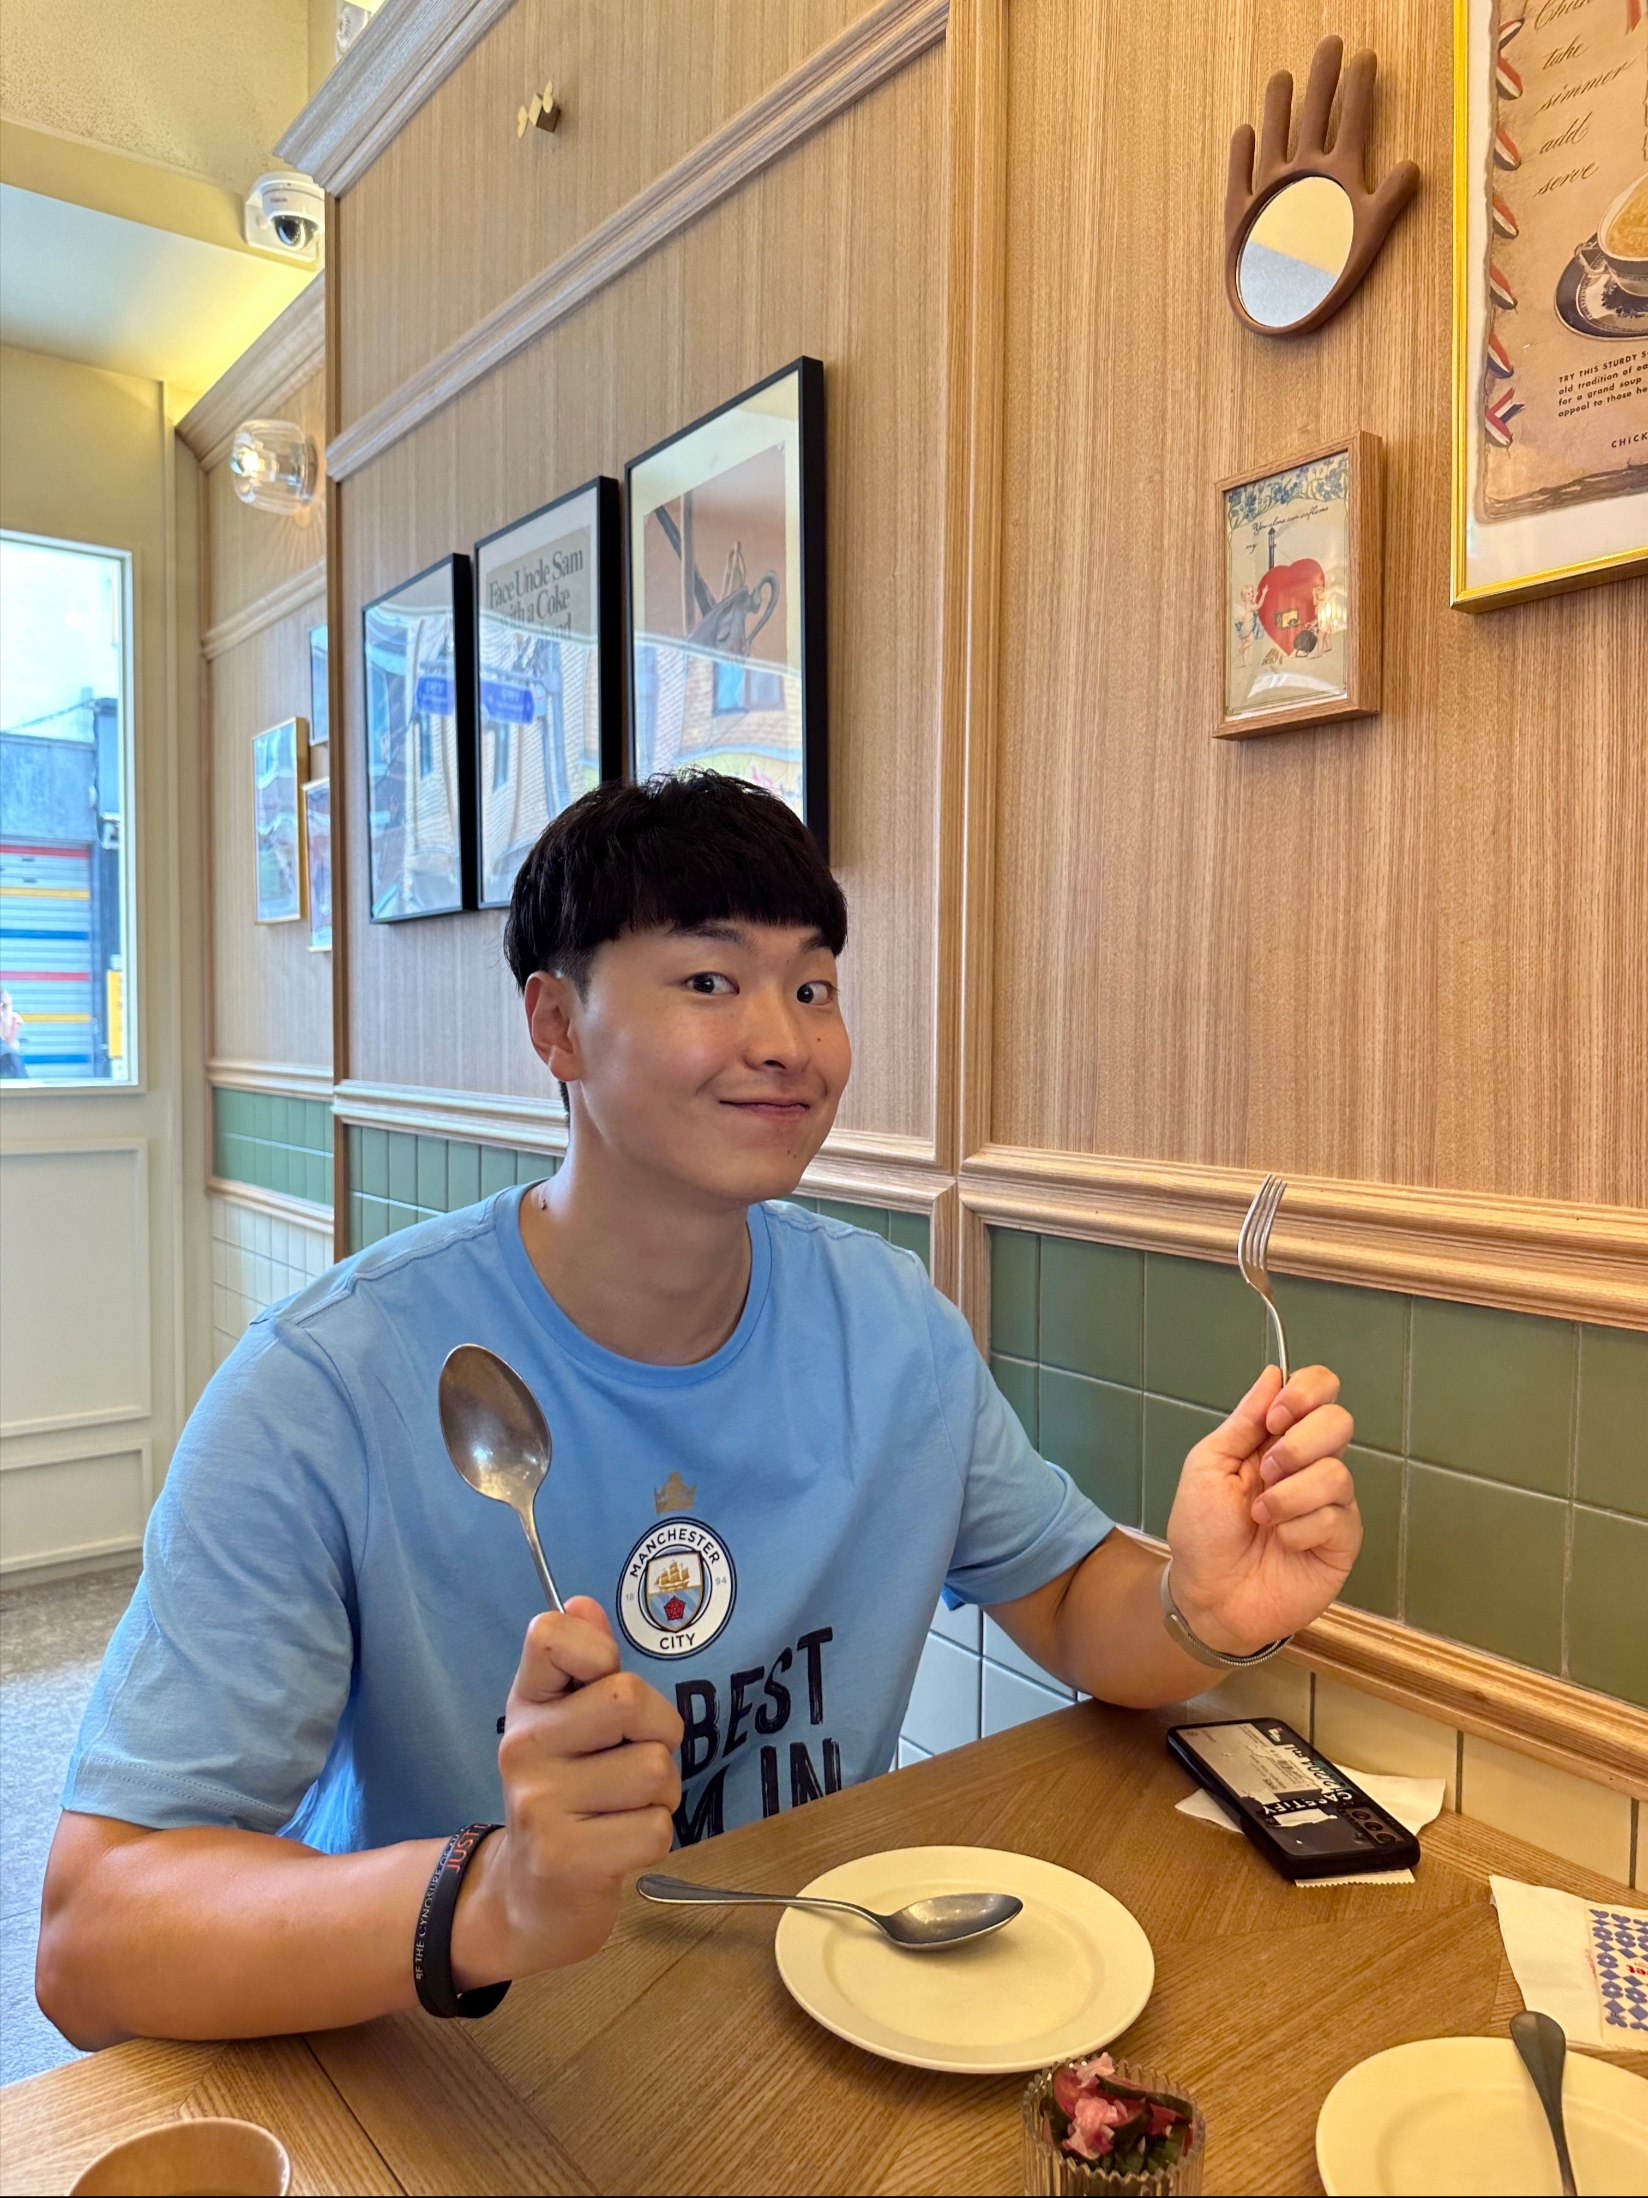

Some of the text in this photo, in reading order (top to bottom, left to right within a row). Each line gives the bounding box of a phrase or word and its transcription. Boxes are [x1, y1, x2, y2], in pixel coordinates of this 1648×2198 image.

[1542, 34, 1592, 70] take
[1534, 55, 1639, 116] simmer
[1540, 111, 1592, 154] add
[1533, 162, 1599, 197] serve
[1559, 373, 1574, 383] TRY
[1579, 366, 1598, 377] THIS
[1603, 354, 1637, 370] STURDY
[1559, 384, 1573, 395] old
[1578, 372, 1618, 389] tradition
[1622, 366, 1632, 376] of
[1558, 397, 1572, 406] for
[1587, 383, 1615, 398] grand
[1620, 377, 1642, 388] soup
[1558, 401, 1589, 417] appeal
[1607, 391, 1632, 403] those
[490, 549, 584, 610] Face Uncle Sam
[537, 584, 571, 619] Coke
[629, 1528, 721, 1578] MANCHESTER
[659, 1633, 696, 1650] CITY
[675, 1626, 833, 1780] BEST
[446, 1829, 480, 1873] JUST
[419, 1868, 442, 1937] CYNOSURE
[415, 1941, 425, 1962] THE
